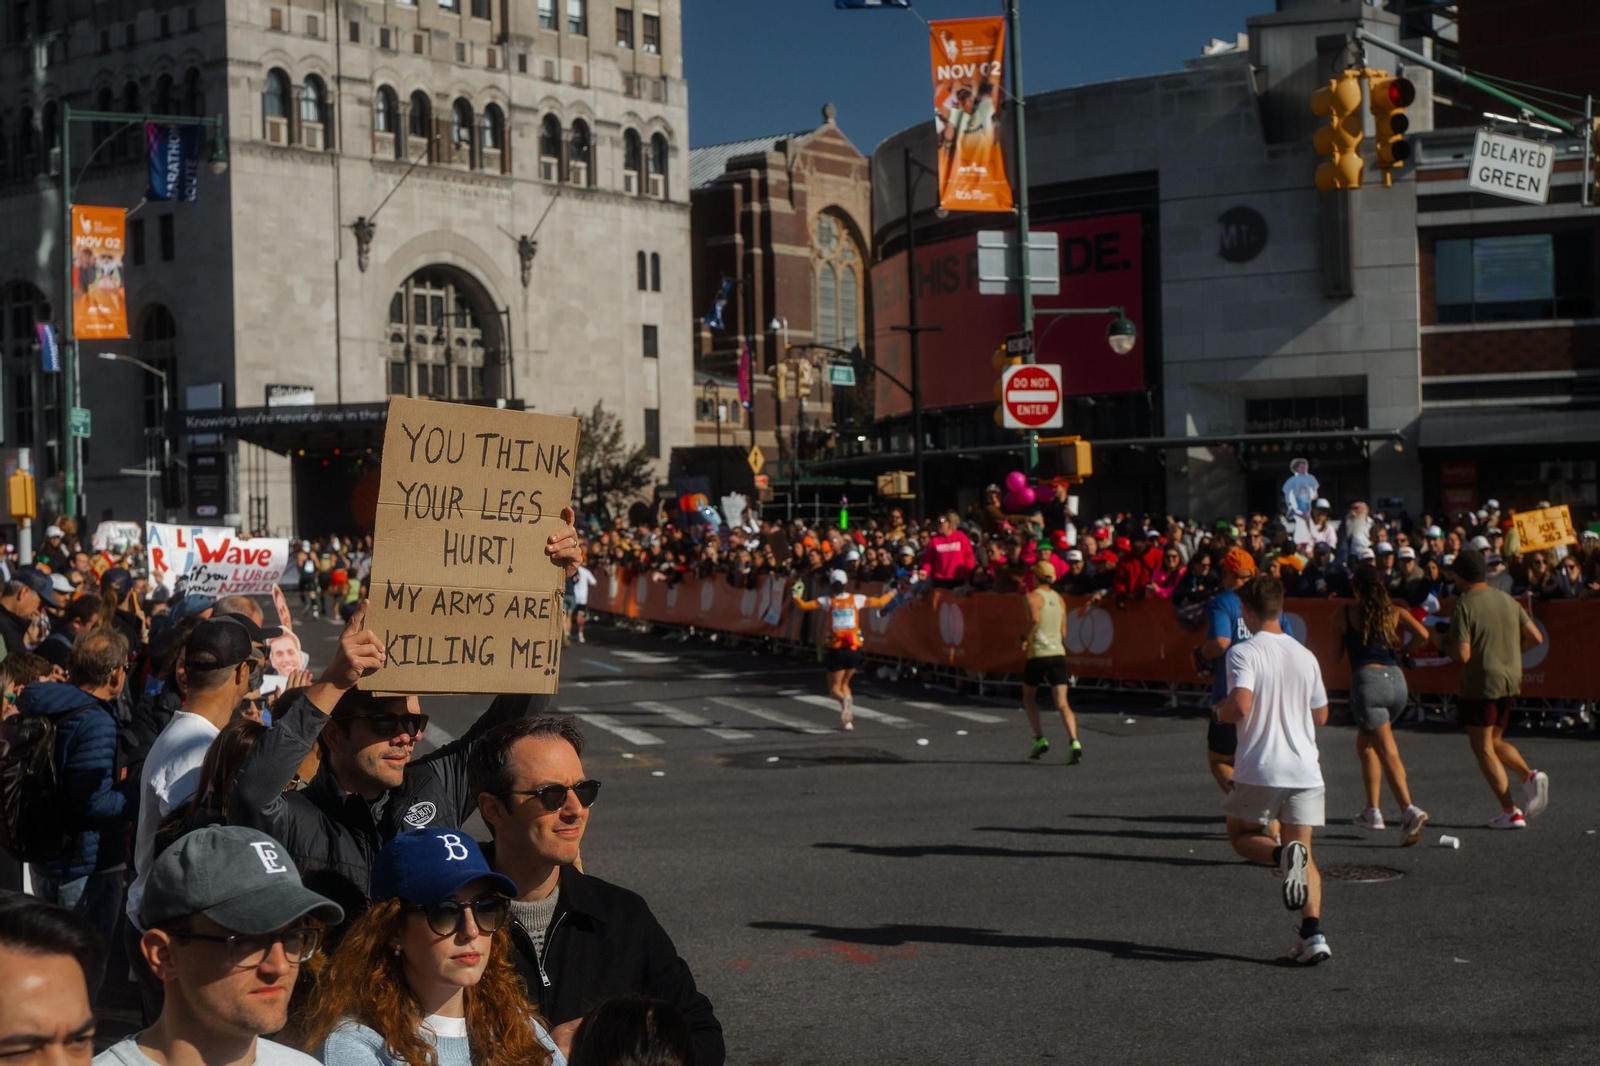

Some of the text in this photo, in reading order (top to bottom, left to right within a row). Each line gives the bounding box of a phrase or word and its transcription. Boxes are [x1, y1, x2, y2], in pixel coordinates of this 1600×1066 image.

[937, 60, 1002, 80] NOV 02
[1480, 140, 1547, 169] DELAYED
[1479, 166, 1541, 193] GREEN
[75, 235, 121, 249] NOV 02
[1013, 377, 1050, 388] DO NOT
[186, 414, 237, 428] Knowing
[276, 412, 309, 425] never
[345, 410, 357, 421] in
[359, 407, 380, 421] the
[1016, 404, 1049, 416] ENTER
[401, 423, 571, 478] YOU THINK
[397, 480, 543, 524] YOUR LEGS
[195, 538, 272, 567] Wave
[444, 529, 515, 574] HURT!
[190, 565, 279, 584] if you LUBED
[187, 584, 217, 593] your
[384, 579, 551, 619] MY ARMS ARE
[384, 629, 559, 676] KILLING ME!!
[406, 812, 421, 822] BEST
[417, 805, 432, 818] BUY
[436, 833, 469, 862] B
